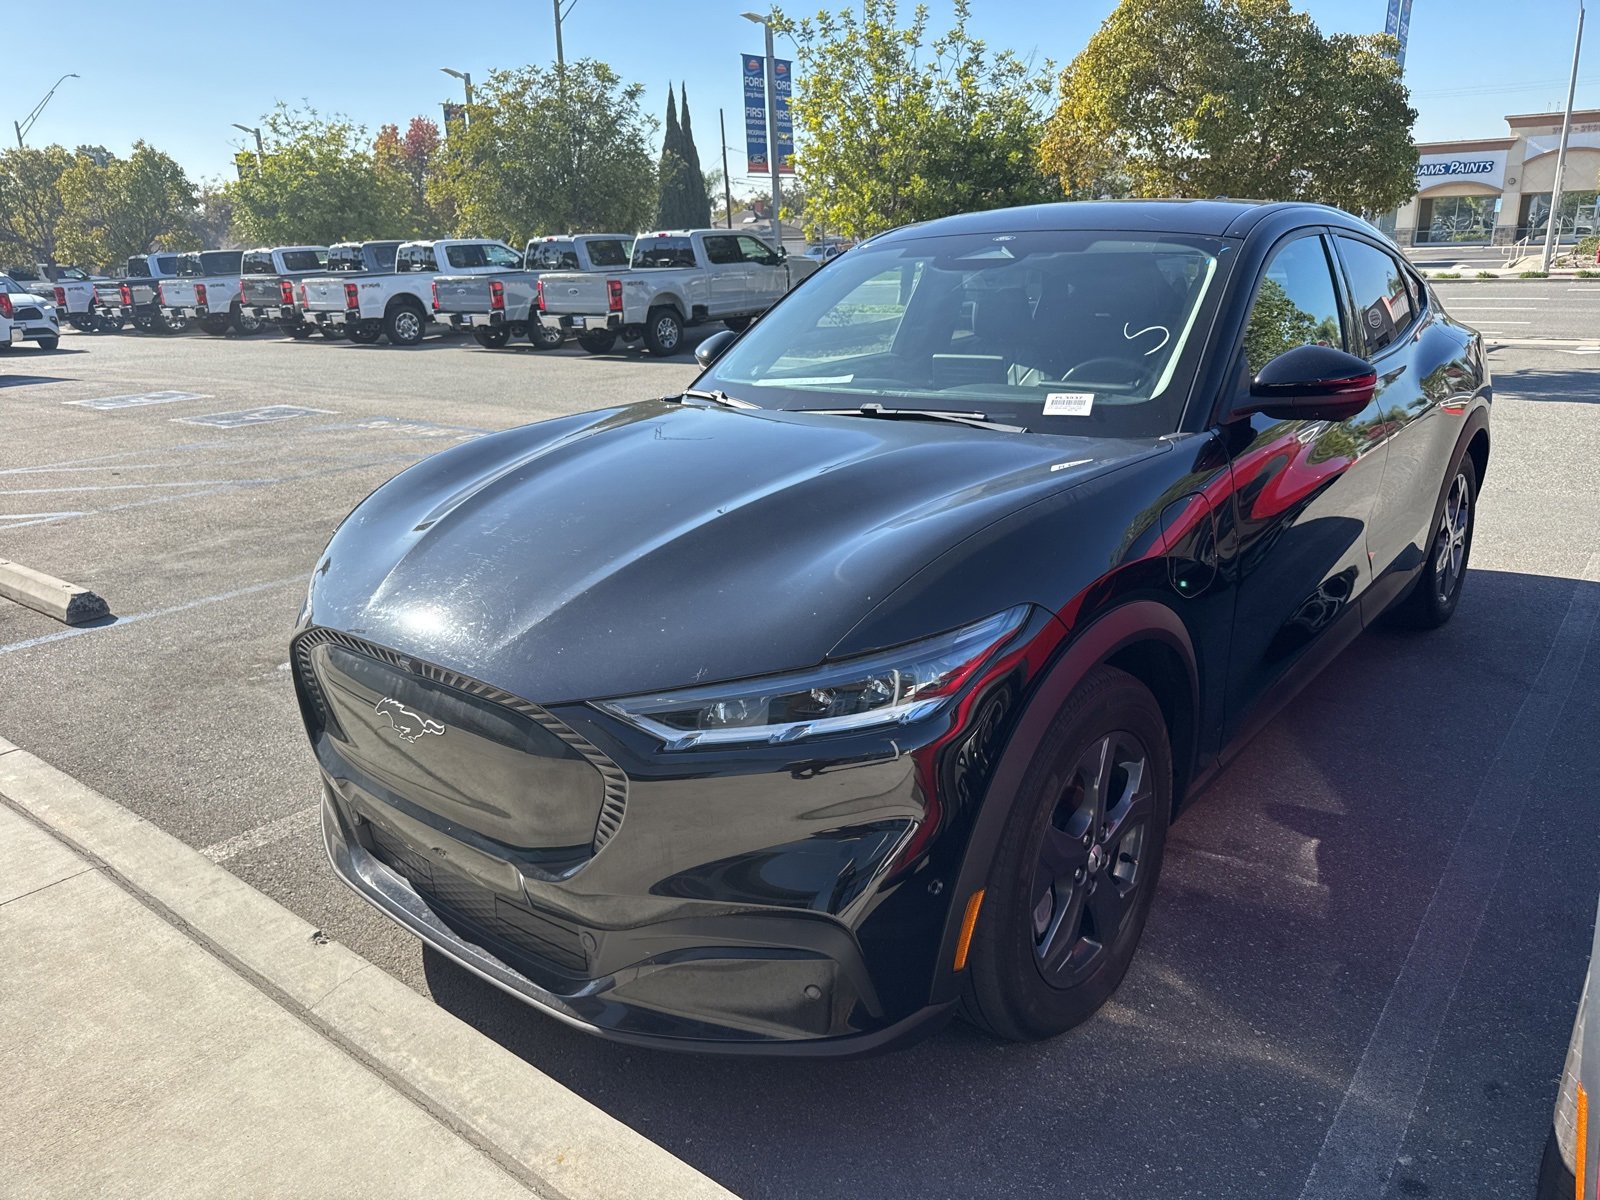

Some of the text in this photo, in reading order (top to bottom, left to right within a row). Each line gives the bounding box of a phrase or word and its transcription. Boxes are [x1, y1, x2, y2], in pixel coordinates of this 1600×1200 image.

[744, 76, 764, 88] FORD
[746, 107, 765, 119] FIRST
[1415, 161, 1494, 176] IAMS PAINTS
